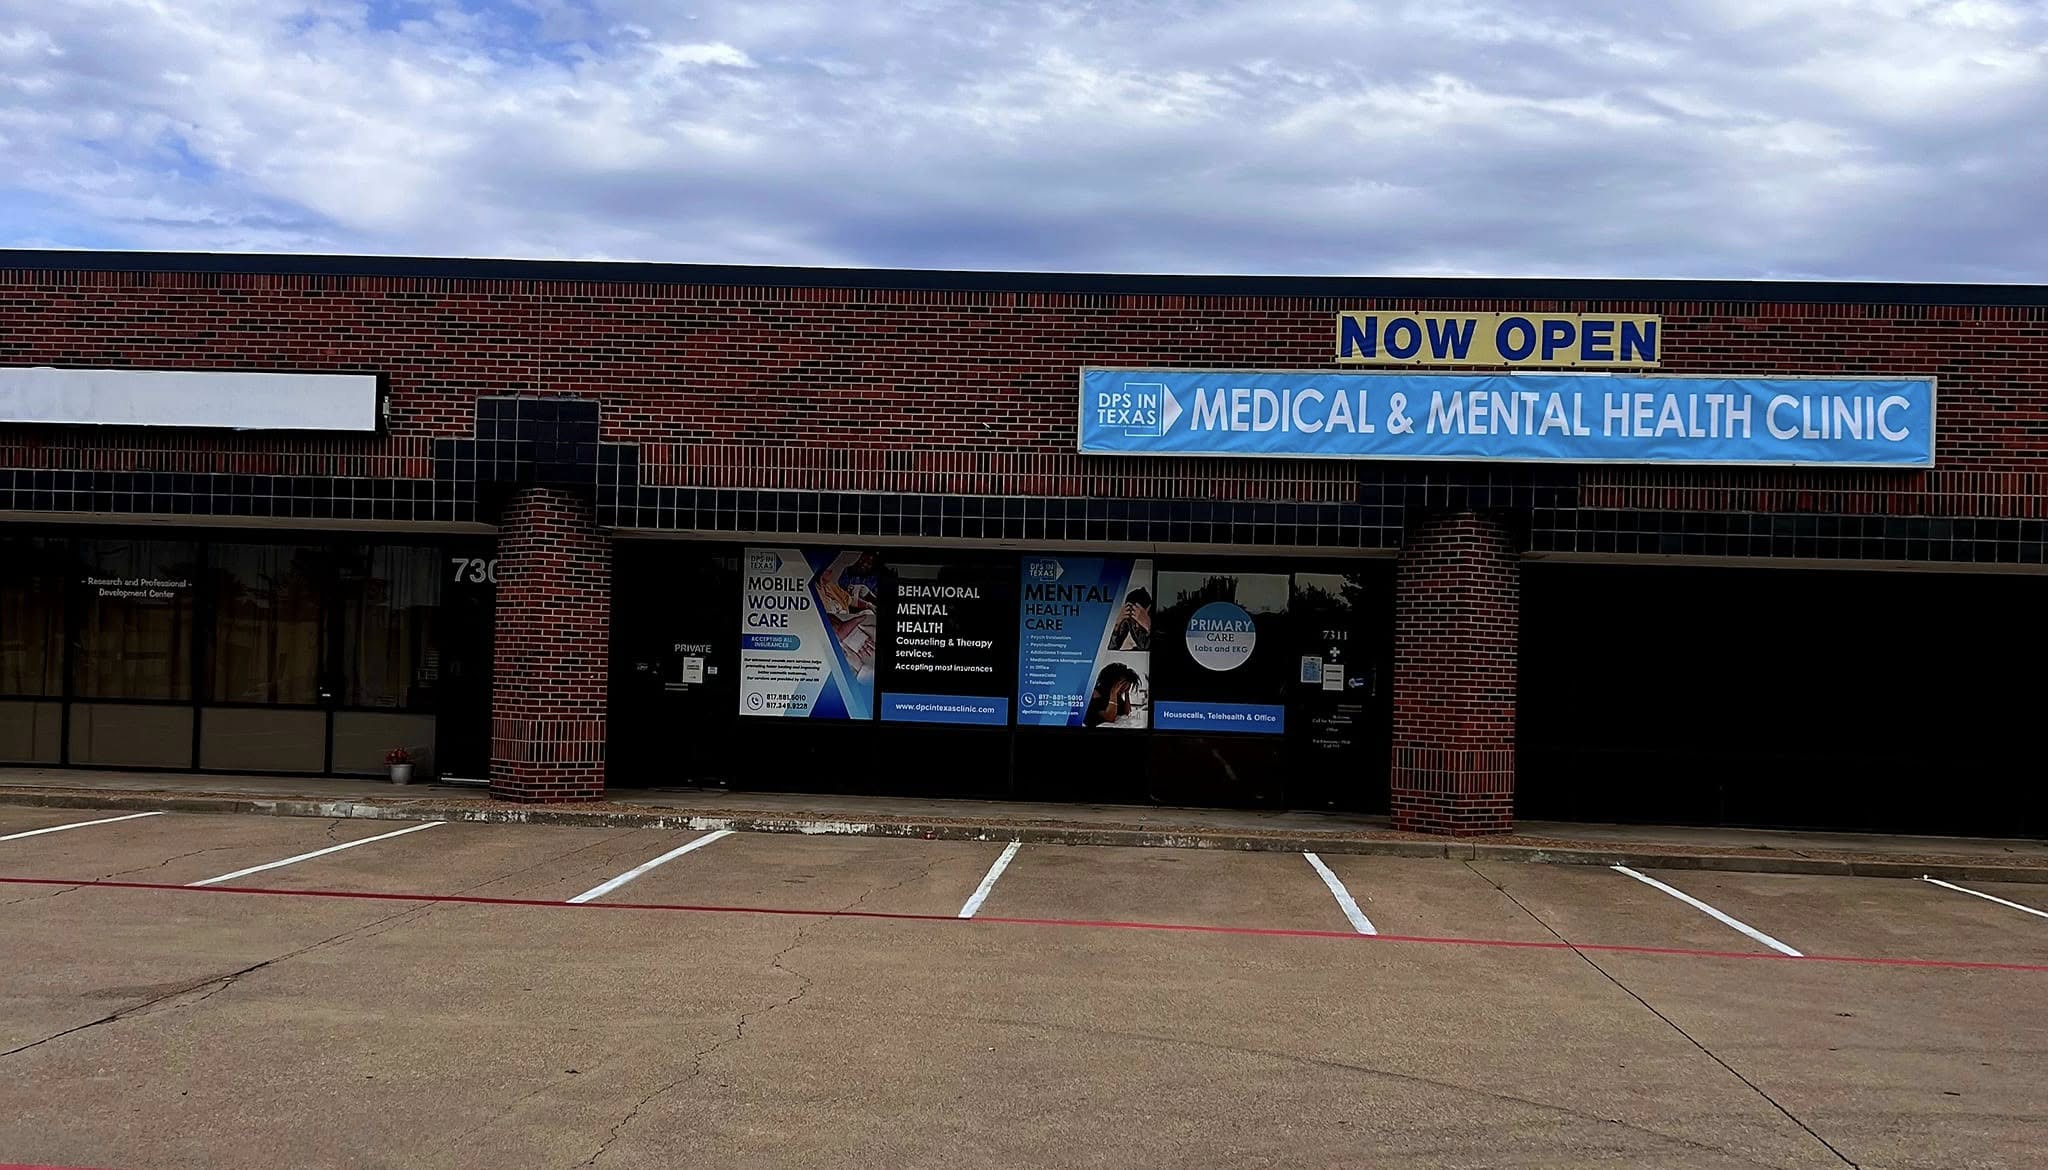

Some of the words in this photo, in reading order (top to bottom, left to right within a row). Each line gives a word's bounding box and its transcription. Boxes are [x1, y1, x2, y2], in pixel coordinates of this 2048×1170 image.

[1340, 316, 1477, 359] NOW
[1495, 317, 1656, 361] OPEN
[1098, 392, 1132, 409] DPS
[1138, 393, 1156, 409] IN
[1097, 409, 1157, 425] TEXAS
[1190, 387, 1375, 433] MEDICAL
[1386, 391, 1414, 435] &
[1426, 390, 1591, 436] MENTAL
[1604, 392, 1752, 438] HEALTH
[1766, 393, 1911, 441] CLINIC
[88, 577, 123, 586] Research
[124, 578, 139, 586] and
[140, 579, 187, 588] Professional
[748, 577, 805, 592] MOBILE
[99, 588, 147, 599] Development
[149, 589, 175, 598] Center
[897, 585, 981, 599] BEHAVIORAL
[1024, 583, 1114, 603] MENTAL
[748, 595, 811, 611] WOUND
[896, 603, 949, 616] MENTAL
[1025, 603, 1080, 617] HEALTH
[747, 613, 789, 628] CARE
[1025, 618, 1063, 631] CARE
[1191, 619, 1252, 632] PRIMARY
[896, 621, 944, 634] HEALTH
[1206, 633, 1235, 642] CARE
[1321, 629, 1348, 641] 7311
[674, 643, 713, 653] PRIVATE
[895, 636, 946, 648] Counseling
[948, 638, 955, 647] &
[956, 638, 993, 649] Therapy
[1195, 645, 1213, 653] Labs
[1214, 645, 1230, 653] and
[895, 649, 935, 658] services.
[895, 662, 934, 672] Accepting
[934, 663, 953, 671] most
[895, 703, 995, 714] www.dpcintexasclinic.com
[1163, 711, 1206, 720] Housecalls,
[1207, 712, 1246, 722] Telehealth
[1246, 714, 1253, 722] &
[1254, 714, 1277, 722] Office
